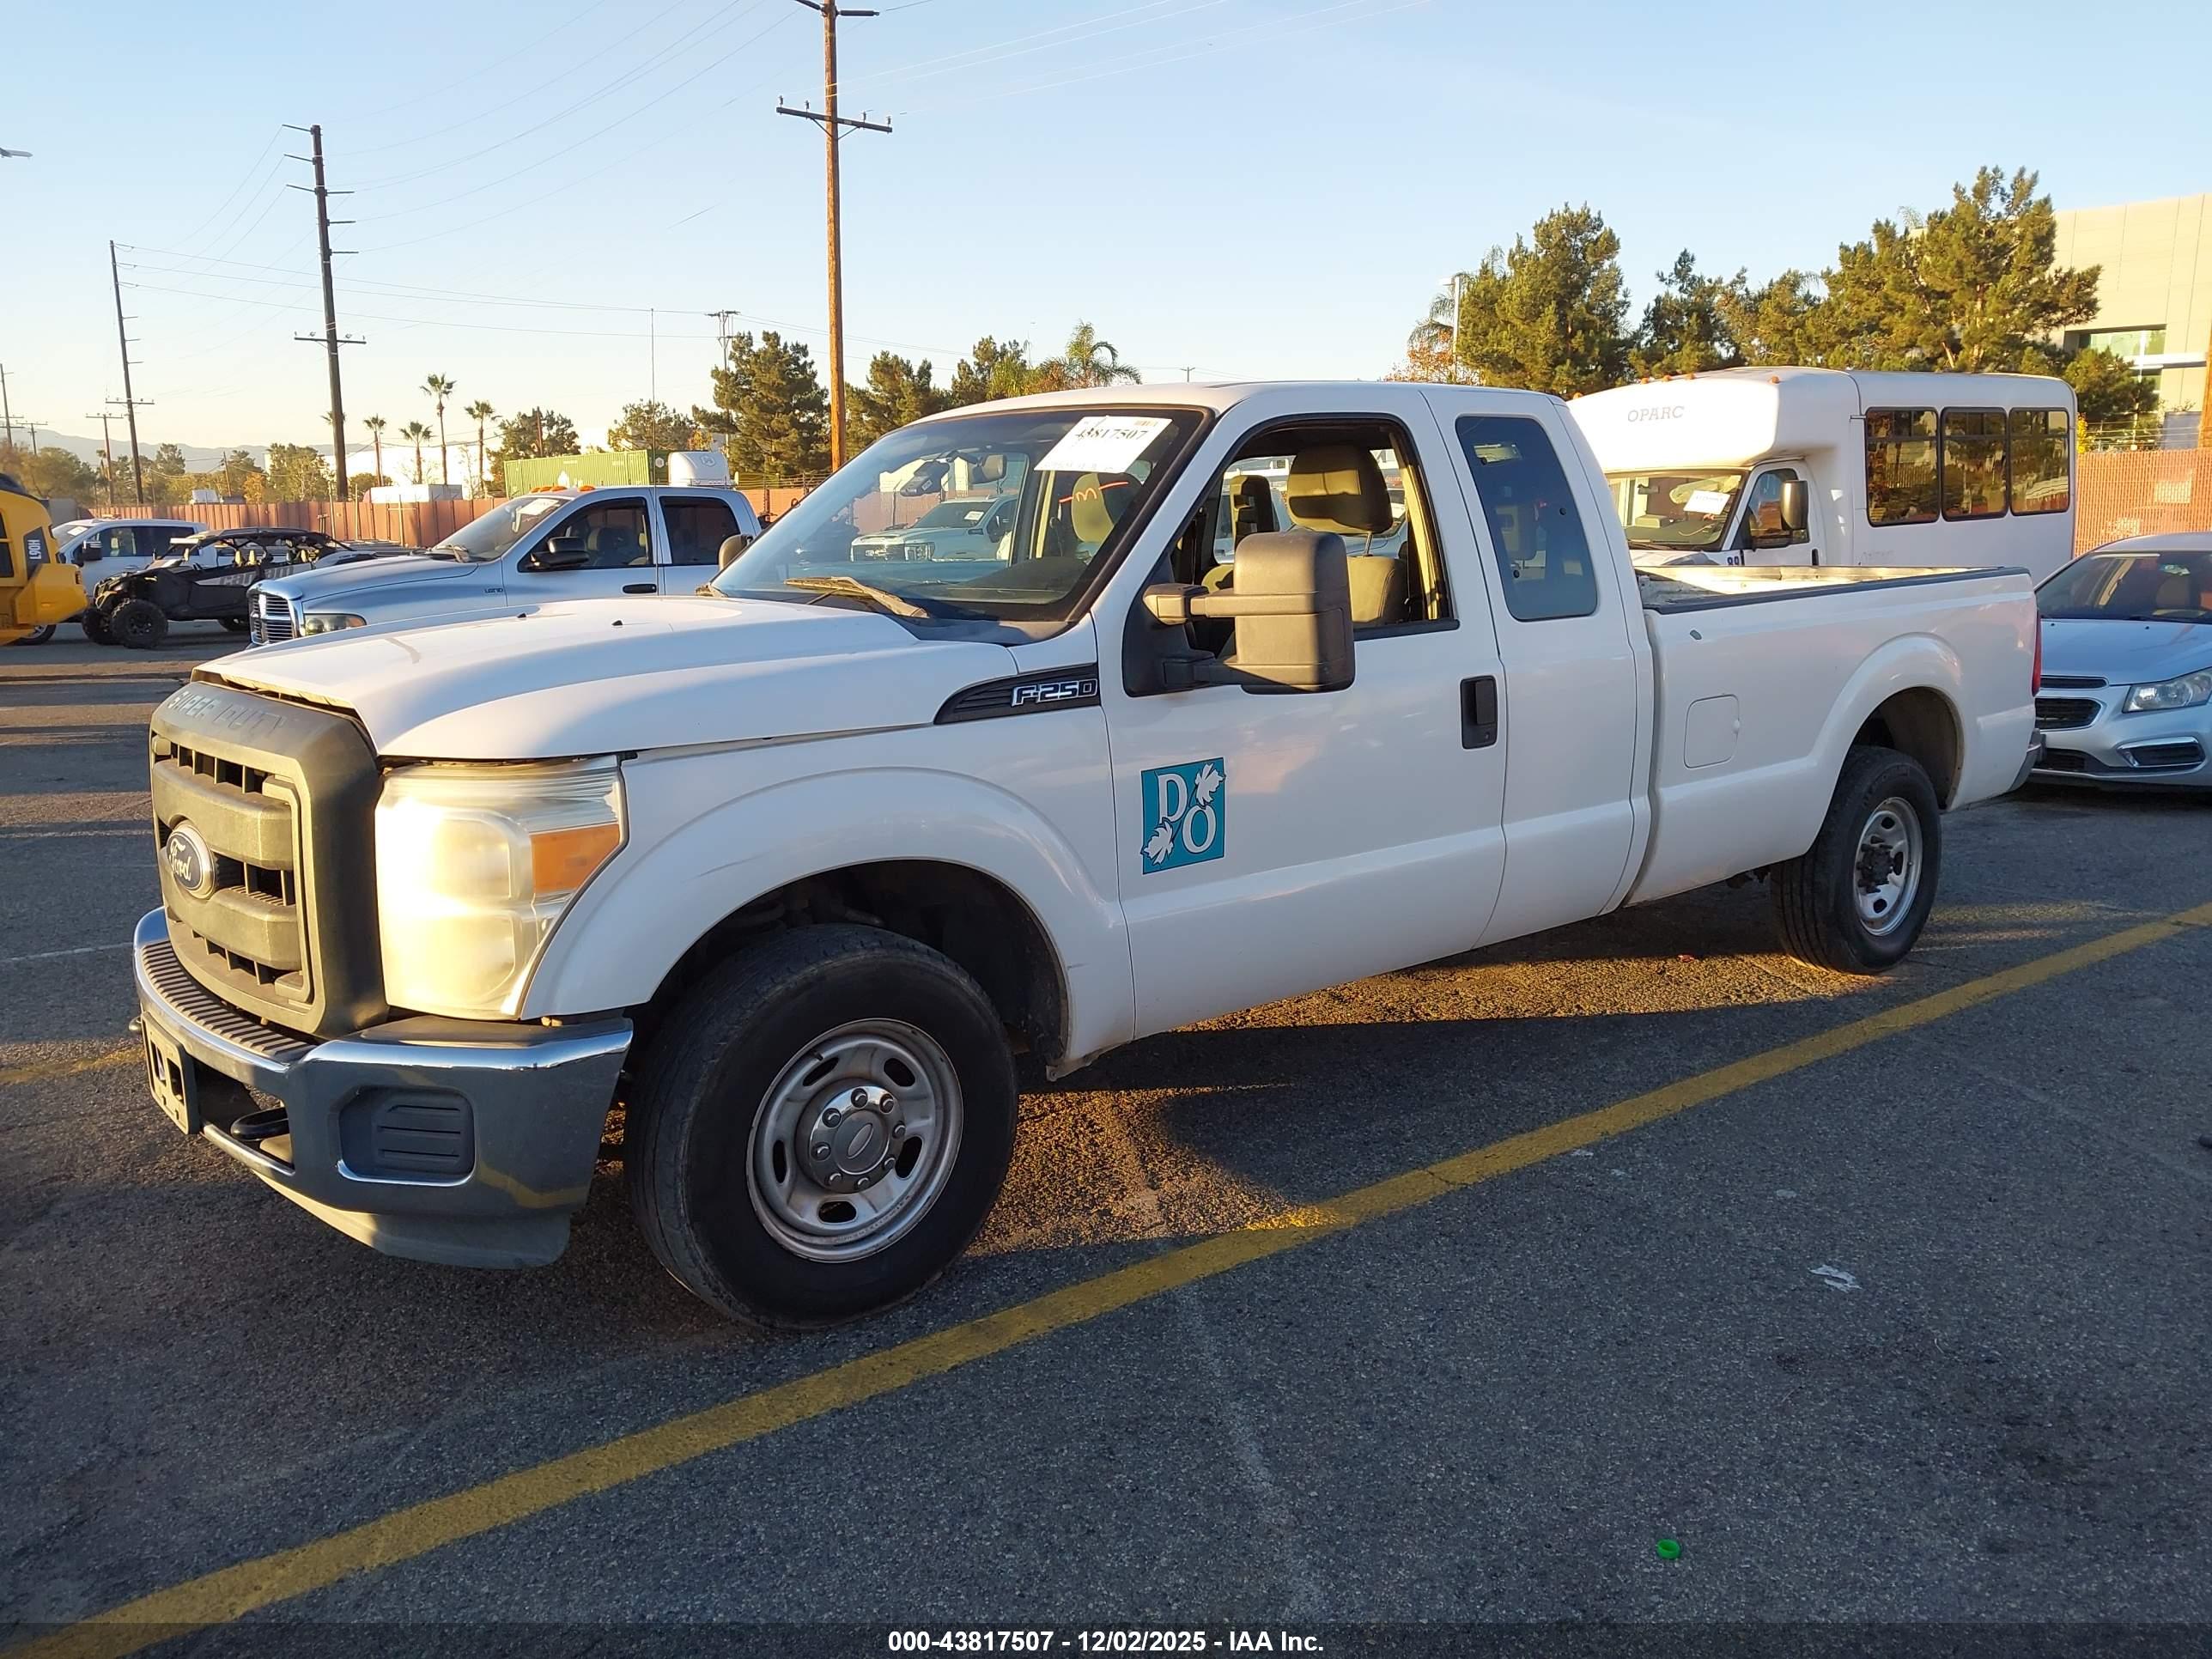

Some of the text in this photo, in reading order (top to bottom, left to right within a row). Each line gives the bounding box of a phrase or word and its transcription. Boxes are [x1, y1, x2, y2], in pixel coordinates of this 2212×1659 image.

[1627, 405, 1685, 422] OPARC
[1012, 678, 1098, 707] F-250
[167, 690, 289, 736] SUPER DUTY
[168, 837, 191, 882] Ford
